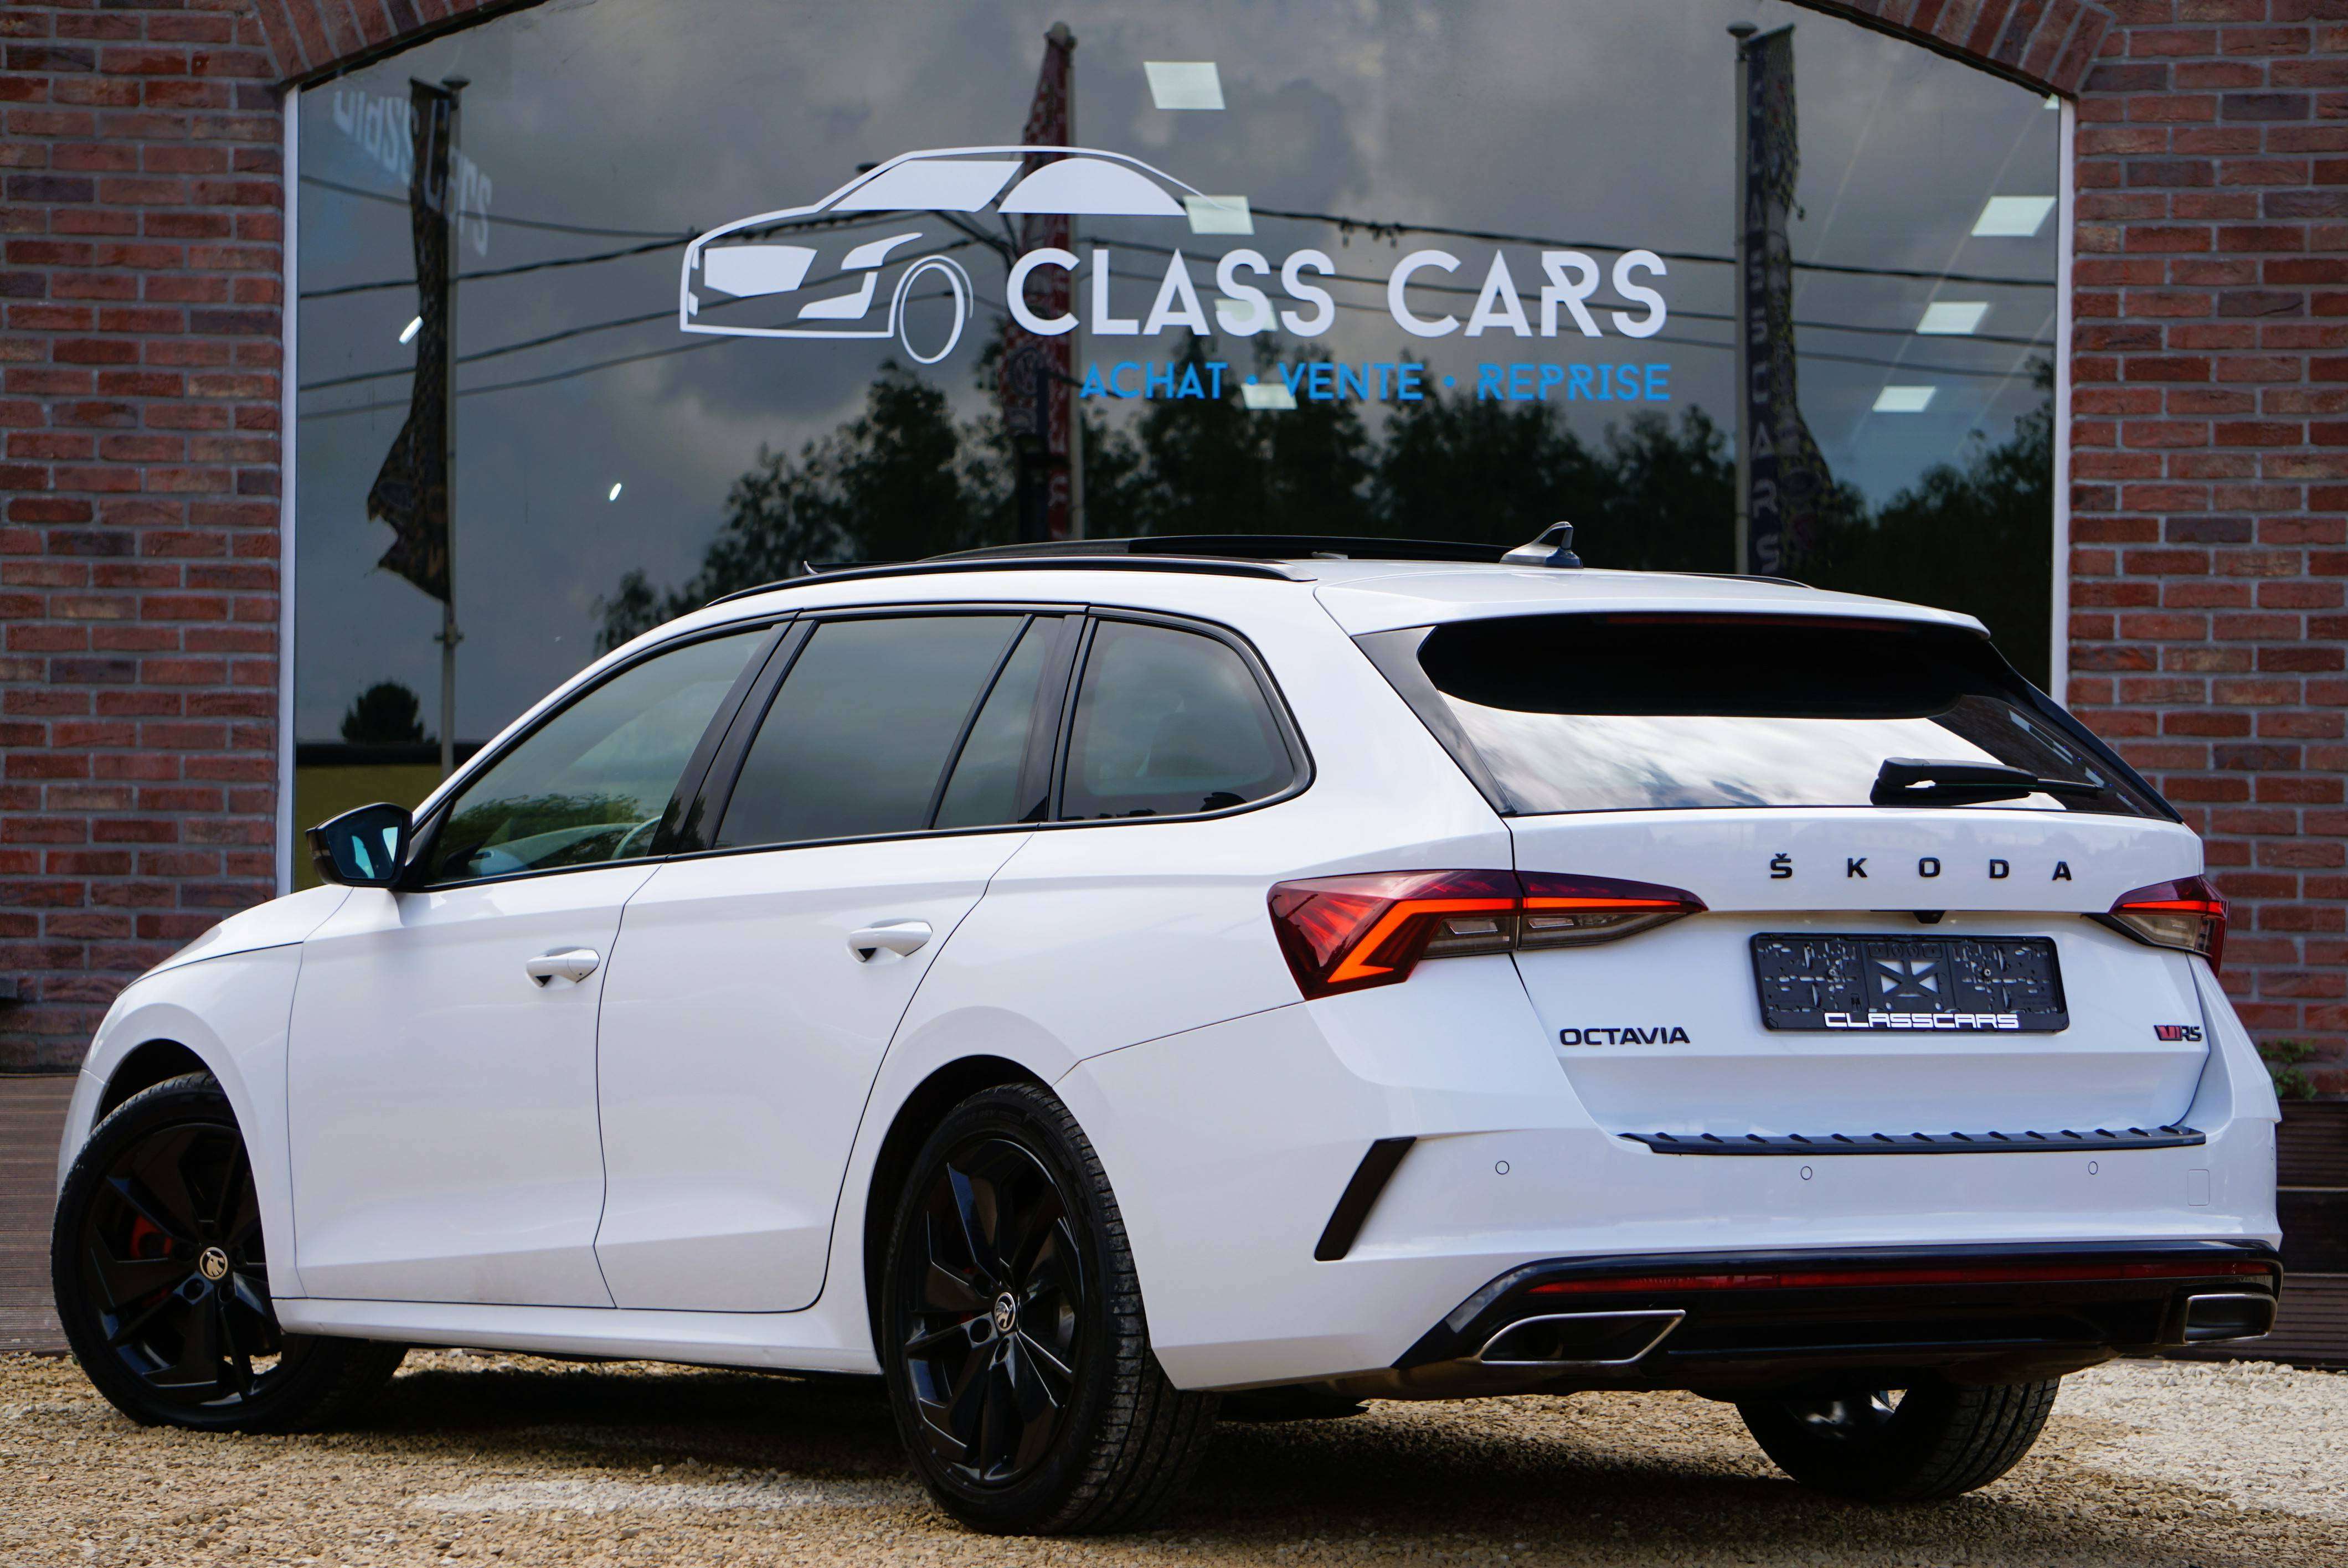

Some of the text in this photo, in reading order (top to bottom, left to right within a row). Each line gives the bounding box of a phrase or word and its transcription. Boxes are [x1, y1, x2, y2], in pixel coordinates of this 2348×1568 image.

[1007, 248, 1667, 338] CLASS CARS
[1079, 360, 1671, 401] ACHAT VENTE REPRISE
[1770, 853, 2072, 881] ŠKODA
[1824, 1012, 2020, 1029] CLASSCARS
[1559, 1027, 1691, 1046] OCTAVIA
